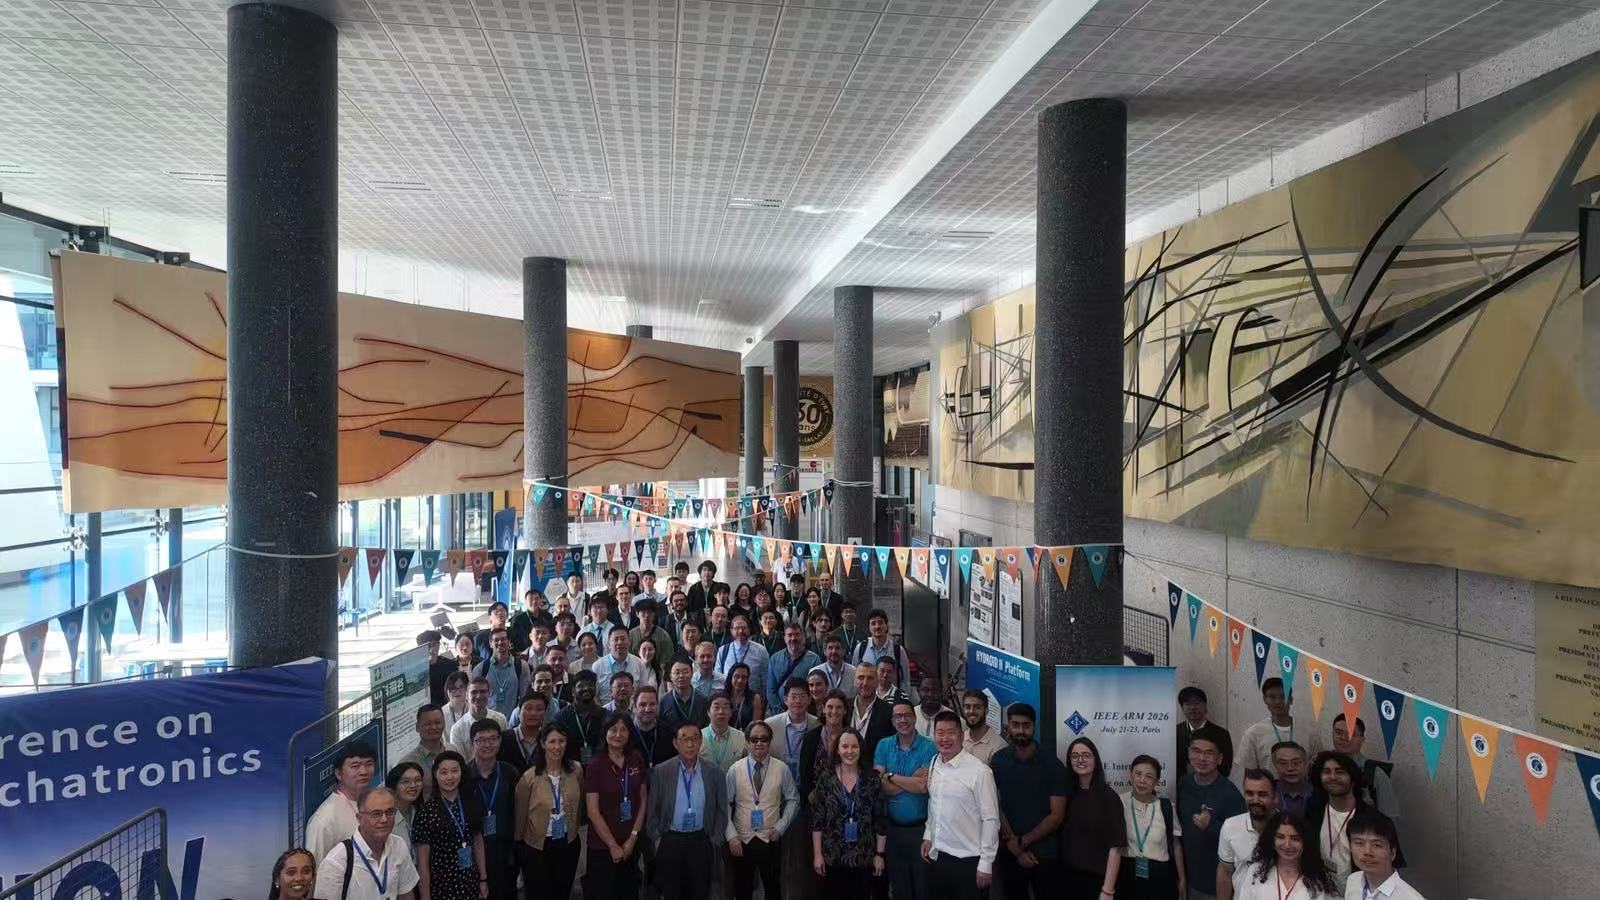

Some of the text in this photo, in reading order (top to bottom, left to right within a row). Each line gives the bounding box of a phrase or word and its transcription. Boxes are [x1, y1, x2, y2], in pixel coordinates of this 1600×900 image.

[1004, 660, 1031, 682] Platform
[1093, 711, 1170, 721] IEEE ARM 2026
[0, 710, 214, 761] rence on
[1100, 726, 1118, 735] July
[0, 748, 262, 808] chatronics
